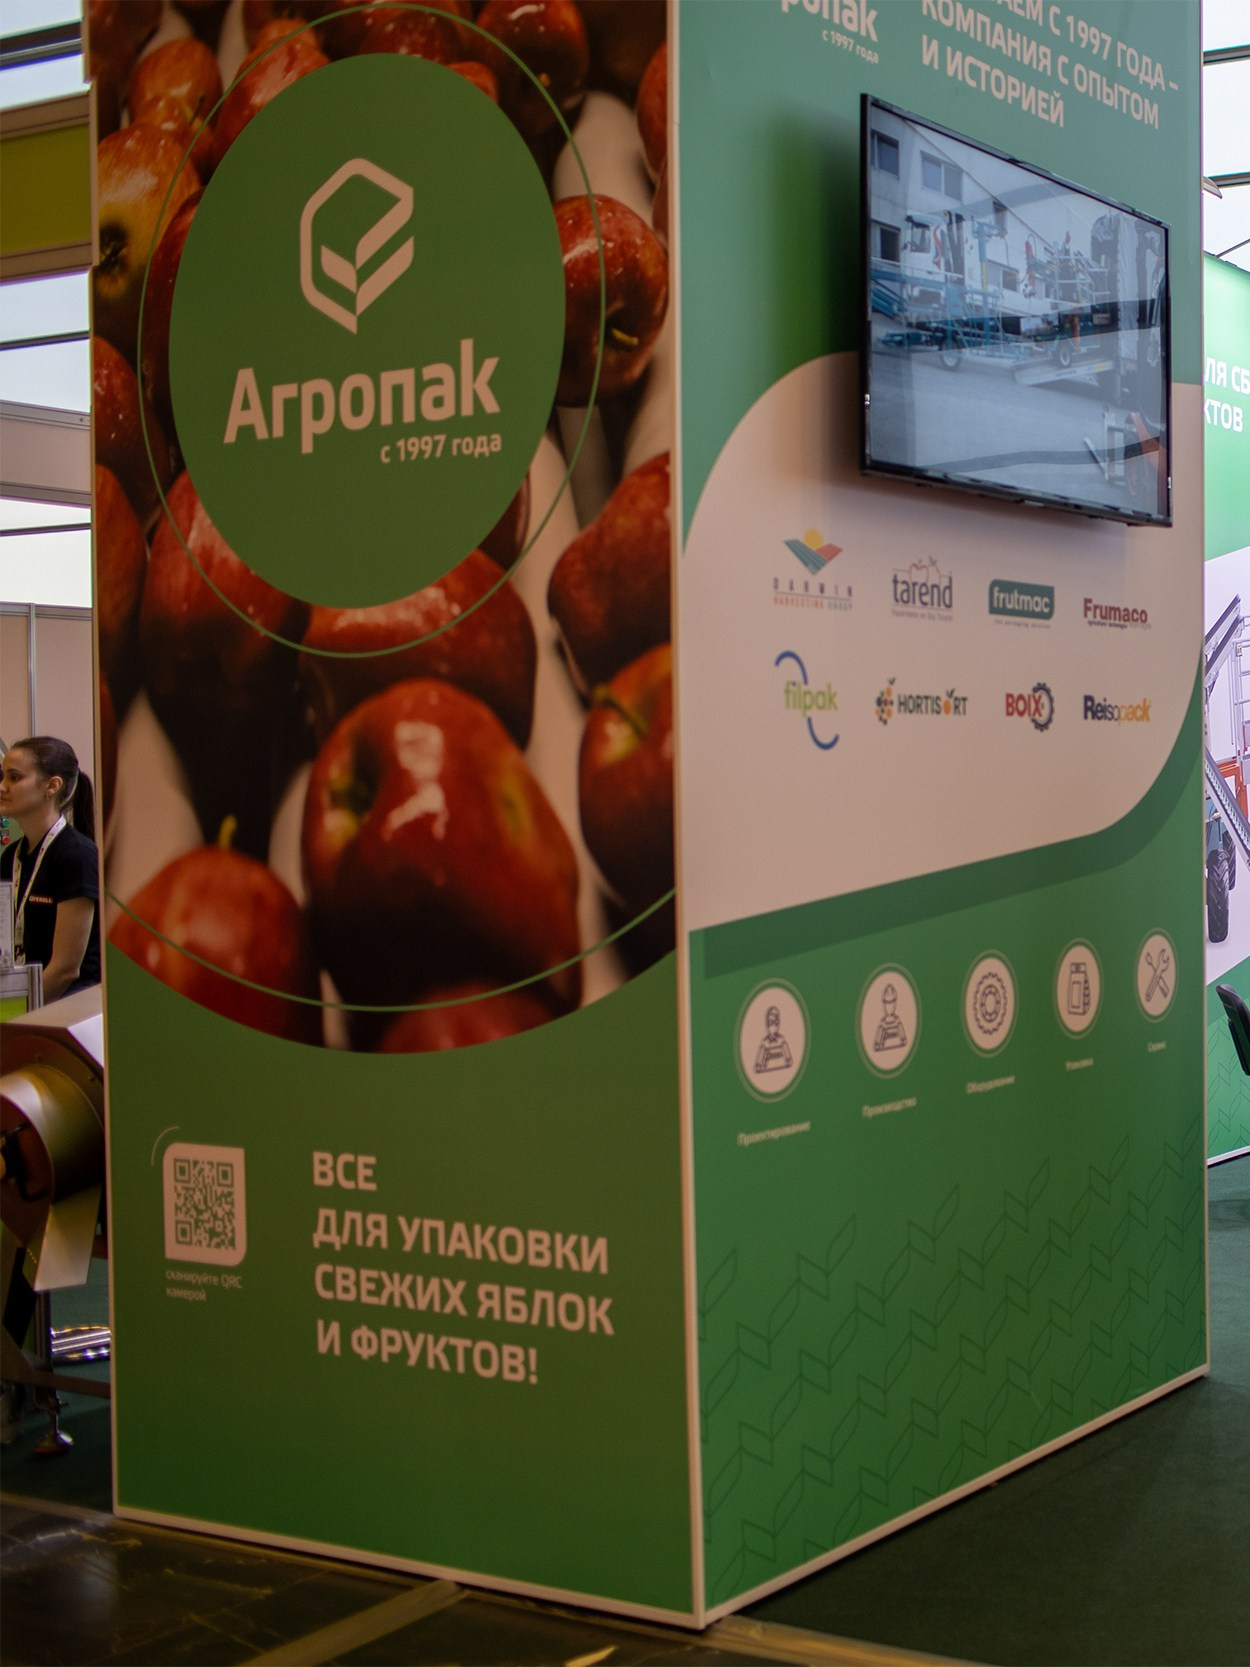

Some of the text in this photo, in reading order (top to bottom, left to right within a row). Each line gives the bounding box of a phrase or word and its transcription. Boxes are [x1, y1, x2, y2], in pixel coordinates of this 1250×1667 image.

[830, 31, 854, 51] 1997
[856, 45, 879, 64] года
[922, 0, 1159, 129] КОМПАНИЯ С ОПЫТОМ
[1049, 6, 1061, 36] С
[1066, 16, 1112, 60] 1997
[1116, 41, 1166, 91] ГОДА
[922, 34, 1064, 128] И ИСТОРИЕЙ
[1204, 356, 1227, 388] ЛЯ
[223, 338, 501, 454] Агропак
[1204, 398, 1243, 432] КТОВ
[396, 434, 447, 462] 1997
[451, 433, 502, 458] года
[892, 573, 953, 609] tarend
[993, 586, 1050, 614] frutmac
[1083, 598, 1148, 623] Frumaco
[784, 681, 838, 717] filpak
[1005, 693, 1043, 718] BOIX
[1084, 695, 1151, 725] Reisopack
[312, 1151, 377, 1191] ВСЕ
[313, 1208, 608, 1274] ДЛЯ УПАКОВКИ
[314, 1264, 615, 1335] СВЕЖИХ ЯБЛОК
[317, 1320, 538, 1384] И ФРУКТОВ!
